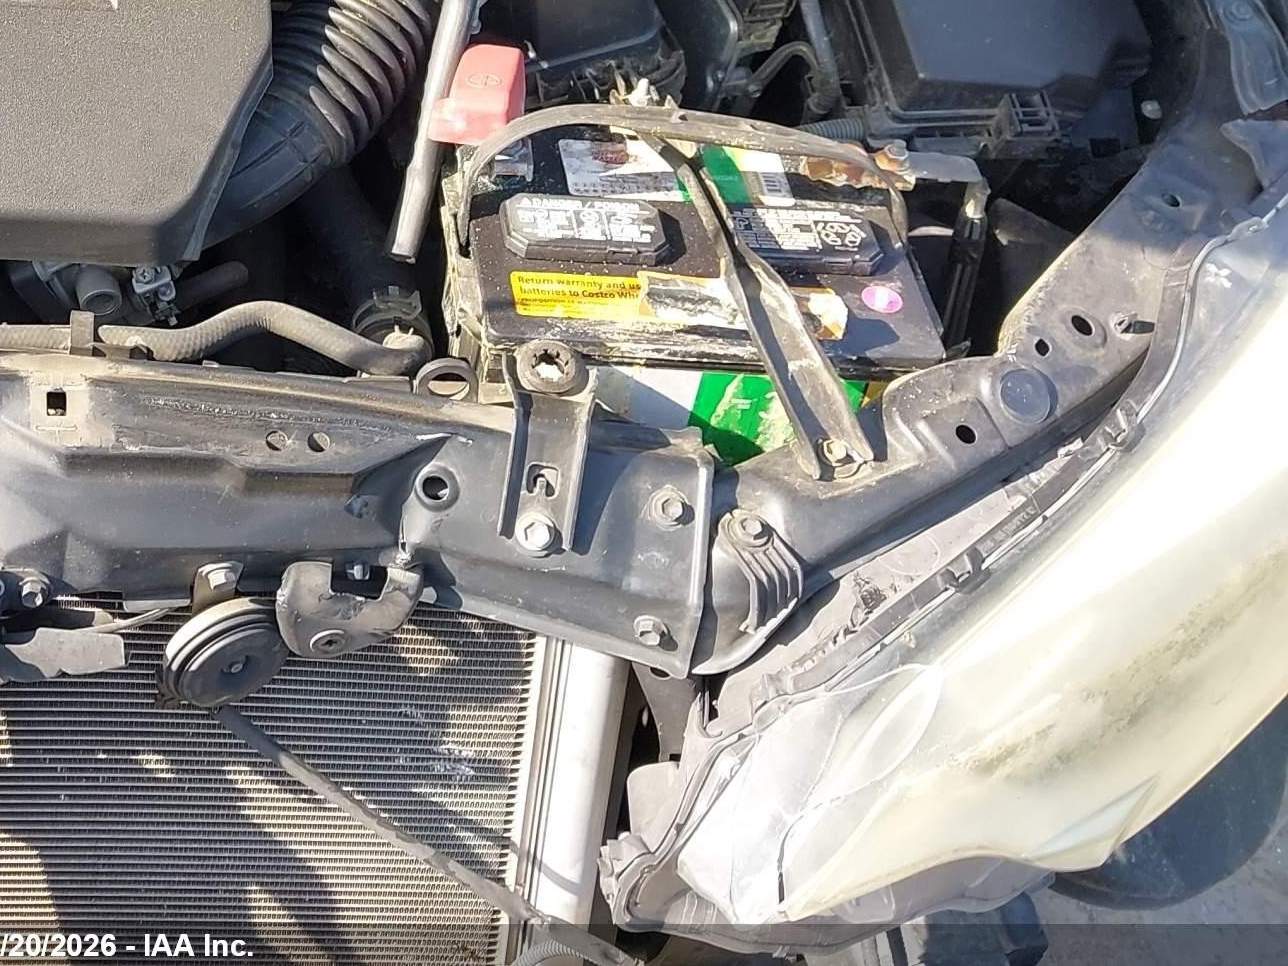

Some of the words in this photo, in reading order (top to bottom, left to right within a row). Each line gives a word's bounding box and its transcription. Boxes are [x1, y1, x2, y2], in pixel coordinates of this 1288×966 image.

[518, 276, 554, 285] Return
[557, 279, 603, 290] warranty
[606, 281, 626, 290] and
[520, 286, 567, 297] batteries
[568, 289, 580, 297] to
[581, 290, 616, 299] Costco
